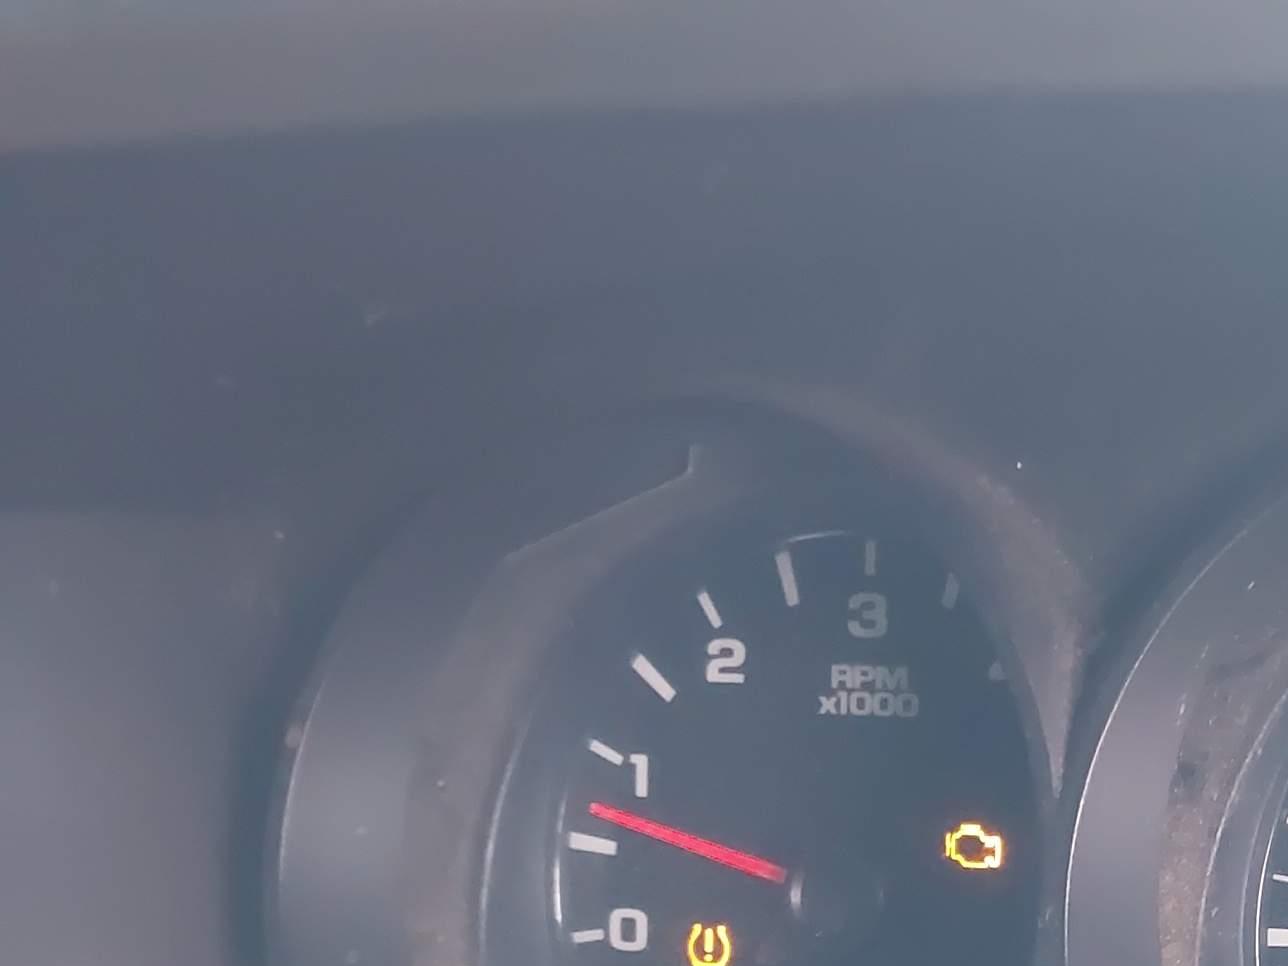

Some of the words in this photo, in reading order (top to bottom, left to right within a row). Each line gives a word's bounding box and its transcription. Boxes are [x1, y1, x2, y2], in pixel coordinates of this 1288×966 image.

[847, 592, 889, 638] 3
[705, 638, 747, 684] 2
[829, 664, 911, 691] RPM
[816, 691, 919, 718] x1000
[628, 753, 650, 798] 1
[608, 908, 649, 952] 0
